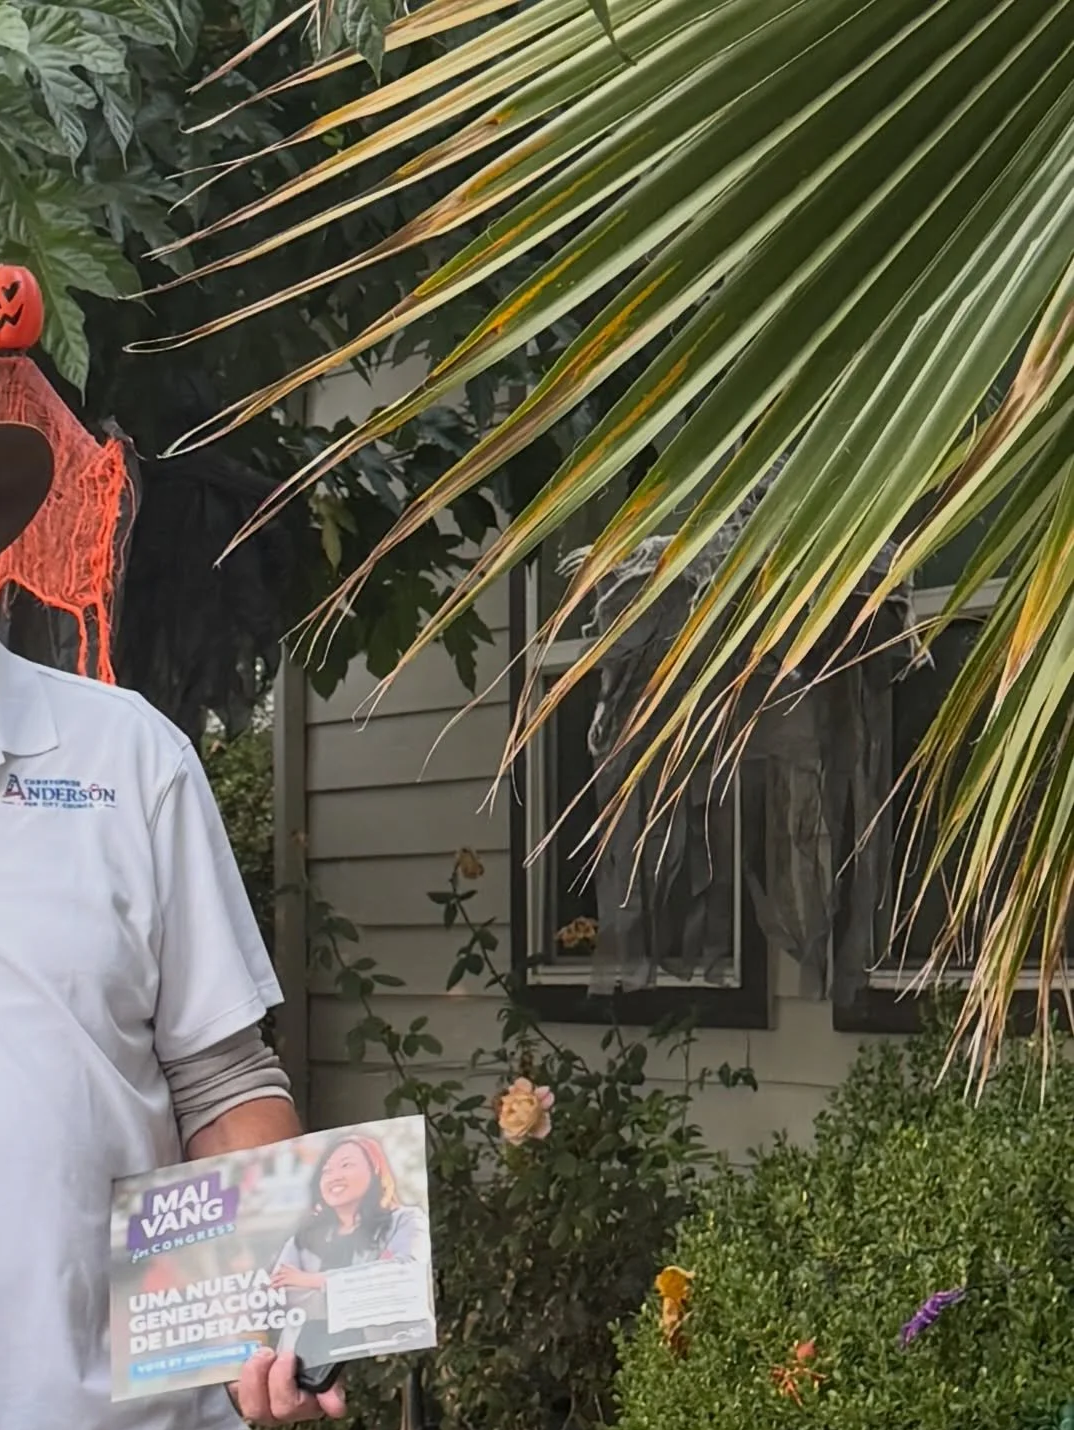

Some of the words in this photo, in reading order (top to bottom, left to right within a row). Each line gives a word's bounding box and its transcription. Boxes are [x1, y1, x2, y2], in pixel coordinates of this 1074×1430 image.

[2, 774, 116, 803] ANDERSON
[141, 1198, 224, 1239] VANG
[151, 1180, 211, 1216] MAI
[150, 1223, 236, 1253] CONGRESS
[129, 1284, 182, 1314] UNA
[186, 1268, 272, 1300] NUEVA
[129, 1284, 287, 1334] GENERACIÓN
[130, 1330, 162, 1355] DE
[166, 1307, 307, 1347] LIDERAZGO
